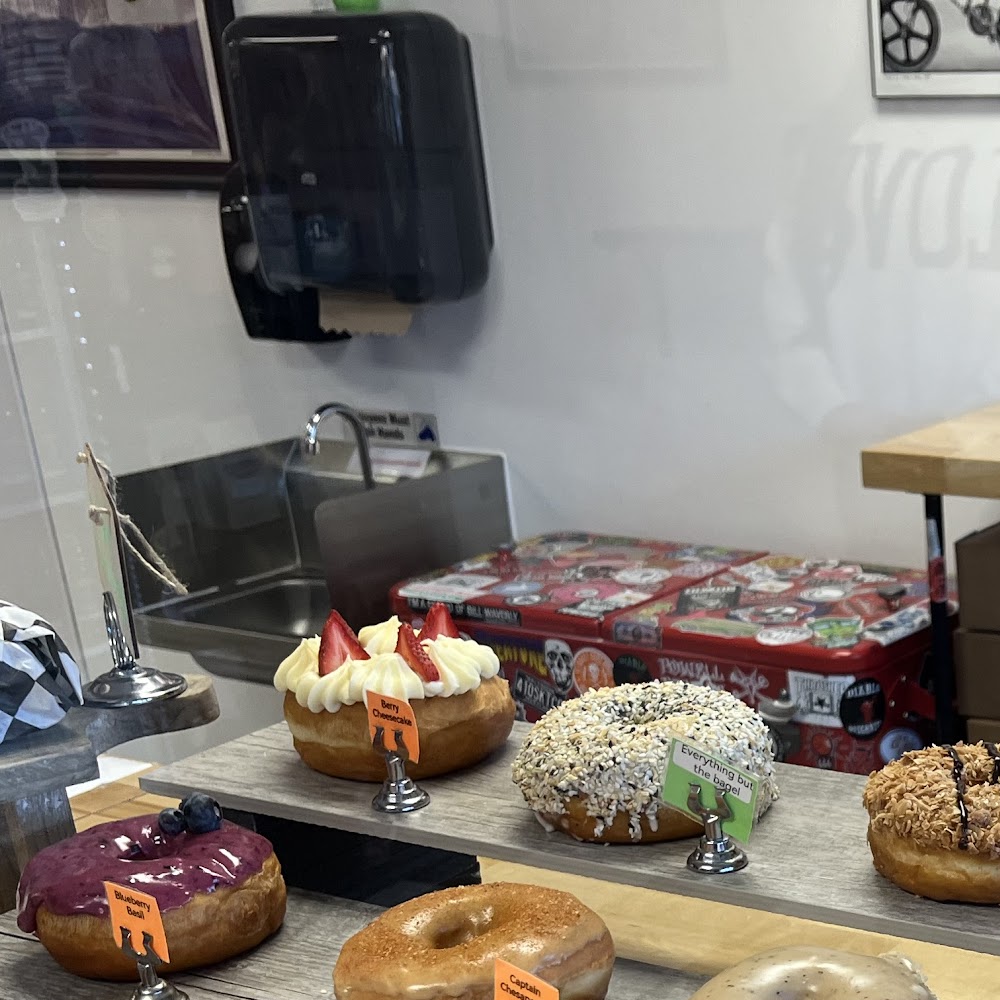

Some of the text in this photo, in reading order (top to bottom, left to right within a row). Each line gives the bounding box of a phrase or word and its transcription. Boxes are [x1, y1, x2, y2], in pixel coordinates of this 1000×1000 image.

[372, 708, 412, 726] Cheesecake
[381, 699, 399, 713] Berry
[681, 744, 753, 791] Everything but
[694, 764, 740, 796] the bagel
[114, 890, 151, 912] Blueberry
[126, 906, 145, 920] Basil
[510, 974, 541, 997] Captain
